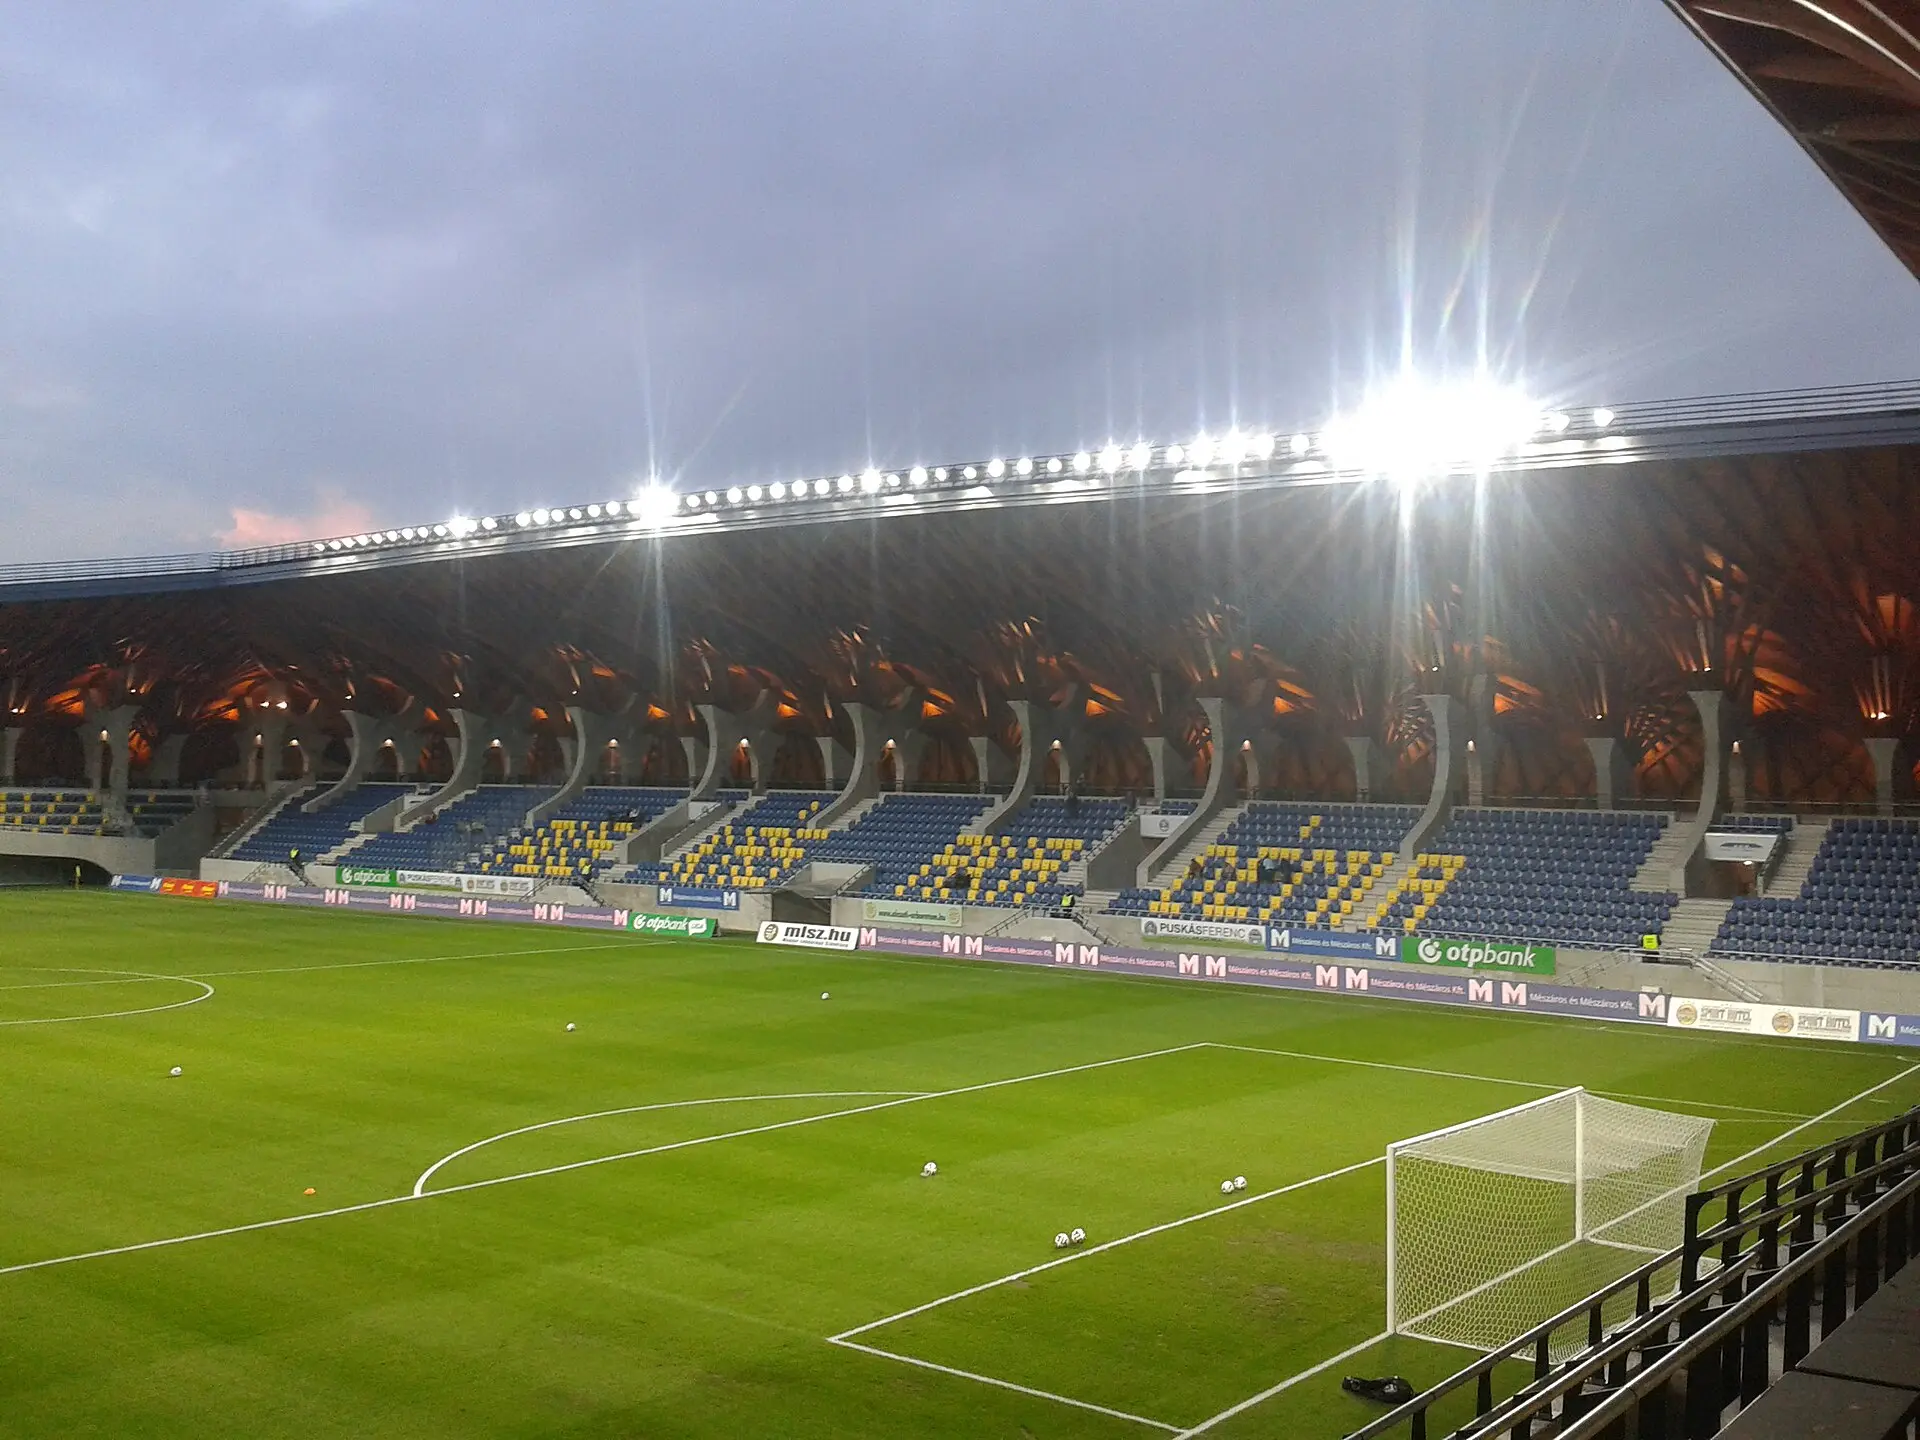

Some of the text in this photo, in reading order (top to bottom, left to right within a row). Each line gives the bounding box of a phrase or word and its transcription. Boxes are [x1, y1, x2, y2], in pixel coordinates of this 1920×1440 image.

[219, 881, 229, 895] M
[264, 884, 275, 899] M
[276, 885, 287, 899] M
[324, 889, 336, 904] M
[338, 890, 350, 904] M
[390, 893, 402, 909] M
[660, 888, 672, 902] M
[724, 892, 736, 906] M
[404, 894, 416, 909] M
[460, 899, 473, 914] M
[475, 900, 487, 915] M
[535, 903, 548, 919] M
[550, 904, 563, 920] M
[614, 909, 628, 925] M
[646, 917, 688, 932] otpbank
[784, 926, 851, 941] mlsz.hu
[1160, 923, 1245, 939] PUSKÁSFERENC
[861, 927, 876, 946] M
[943, 934, 960, 953] M
[965, 937, 982, 956] M
[1056, 943, 1074, 963] M
[1271, 928, 1290, 947] M
[1376, 936, 1396, 956] M
[1080, 945, 1098, 965] M
[1179, 953, 1199, 974] M
[1446, 943, 1536, 968] otpbank
[1206, 956, 1226, 977] M
[1316, 965, 1337, 987] M
[1346, 968, 1368, 990] M
[1469, 979, 1492, 1002] M
[1502, 982, 1527, 1006] M
[1639, 993, 1665, 1018] M
[1868, 1014, 1896, 1038] M
